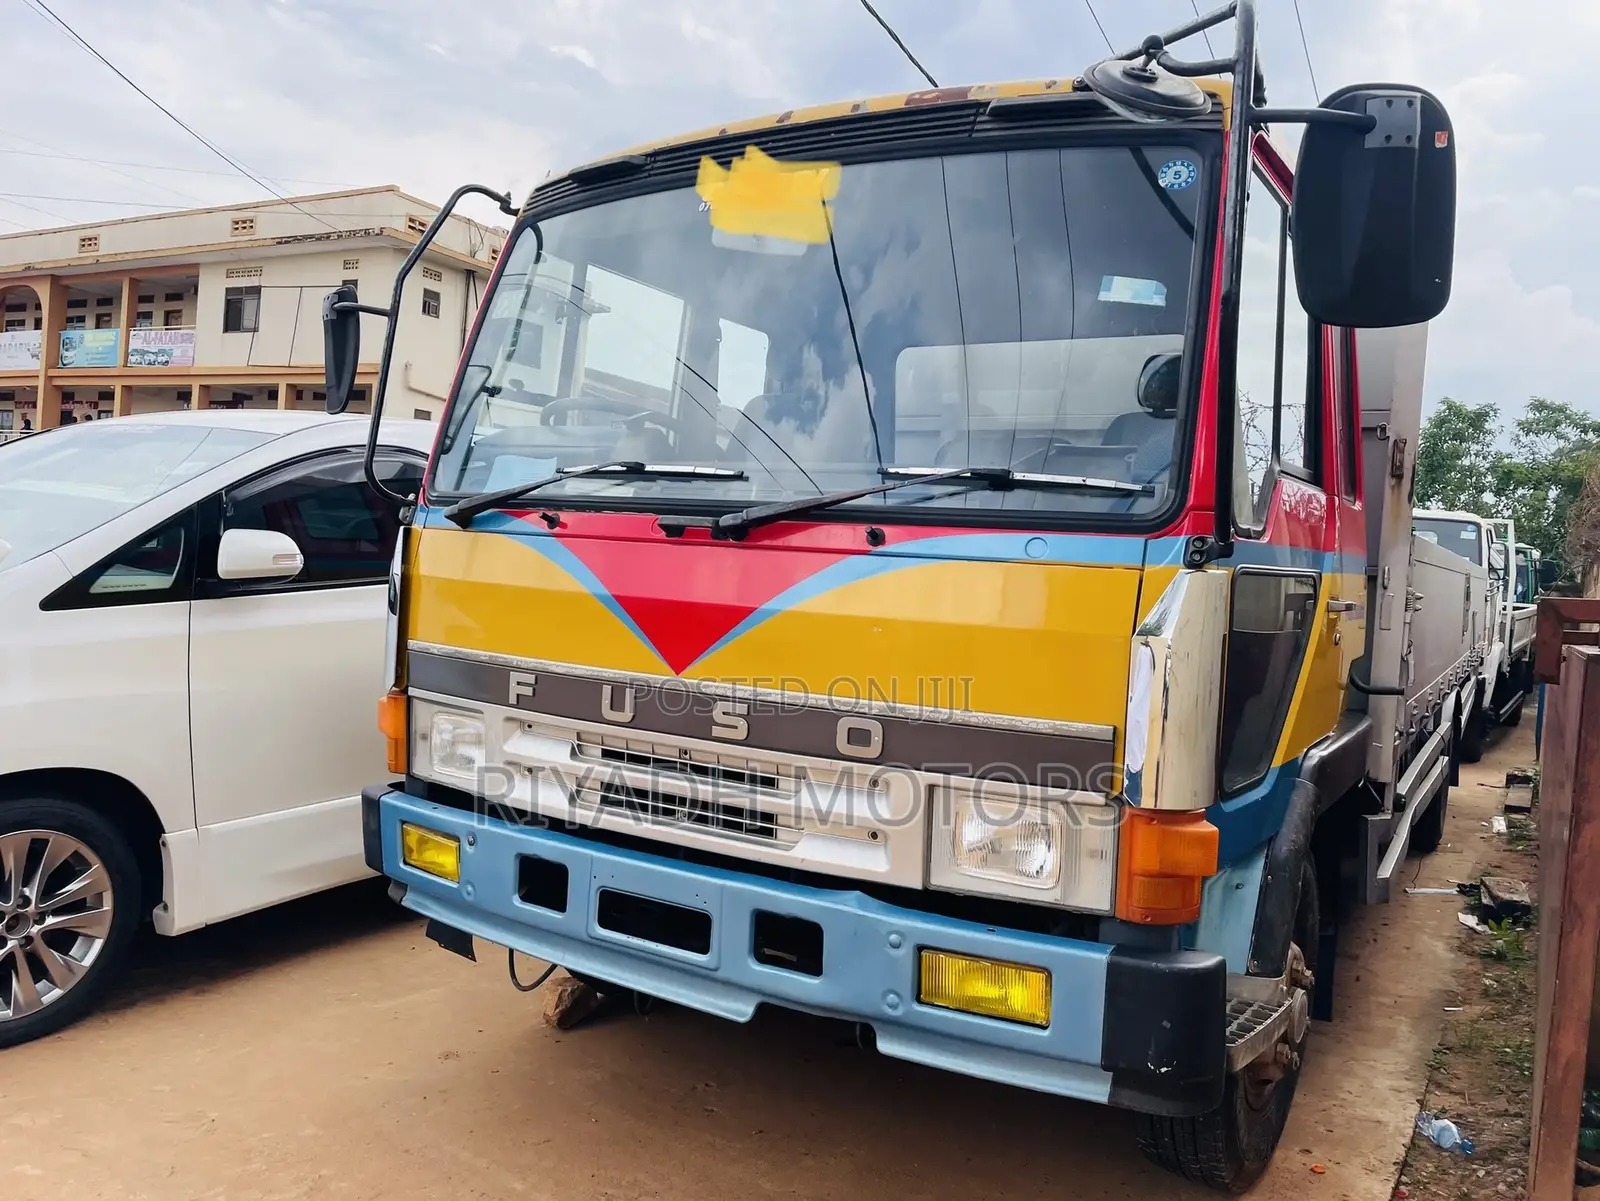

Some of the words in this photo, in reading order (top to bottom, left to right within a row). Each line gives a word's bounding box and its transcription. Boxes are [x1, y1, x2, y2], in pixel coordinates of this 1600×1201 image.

[1173, 171, 1182, 180] 5
[698, 201, 713, 212] 07
[508, 671, 884, 759] FUSO
